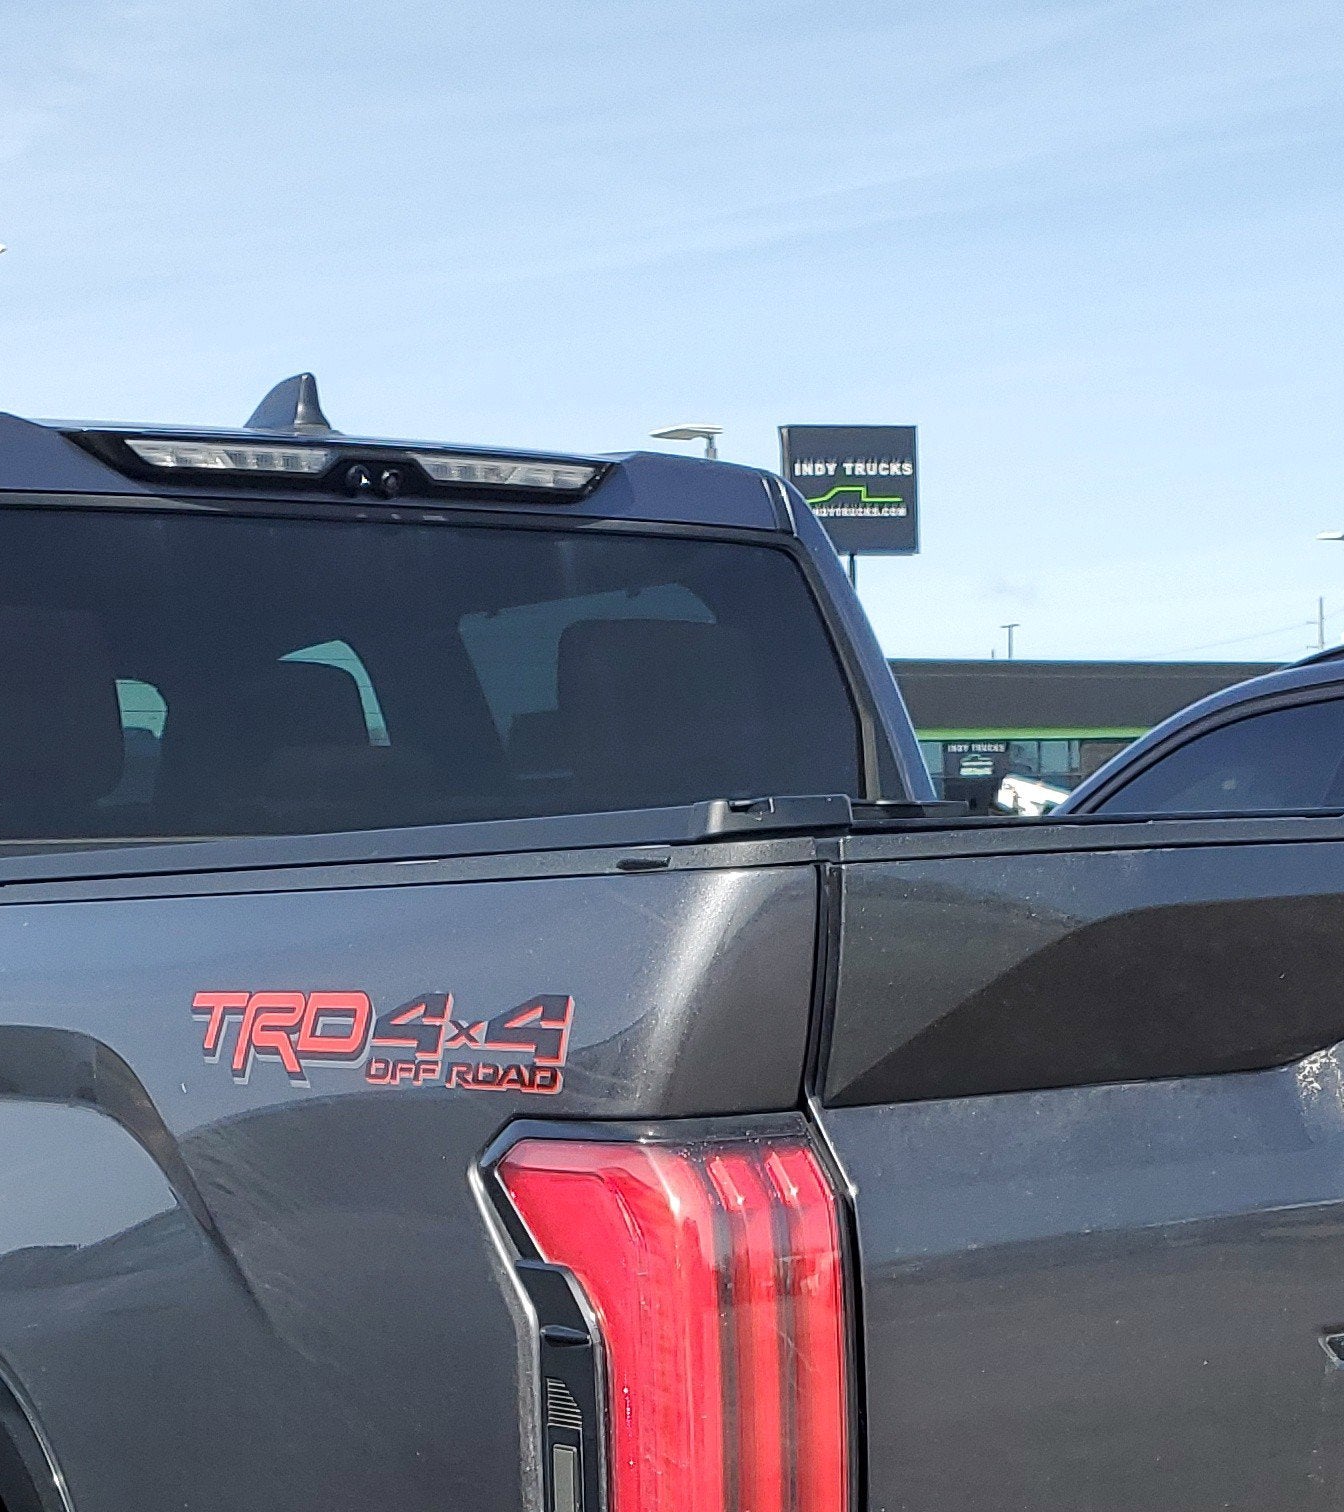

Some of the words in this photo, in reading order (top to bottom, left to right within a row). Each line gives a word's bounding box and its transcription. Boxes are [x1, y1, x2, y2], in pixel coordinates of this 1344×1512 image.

[794, 462, 838, 476] INDY
[843, 462, 914, 476] TRUCKS
[811, 506, 907, 517] NDYTRUCKS.COM
[191, 990, 376, 1089] TRD
[365, 1056, 442, 1086] OFF
[445, 1061, 564, 1095] ROAD
